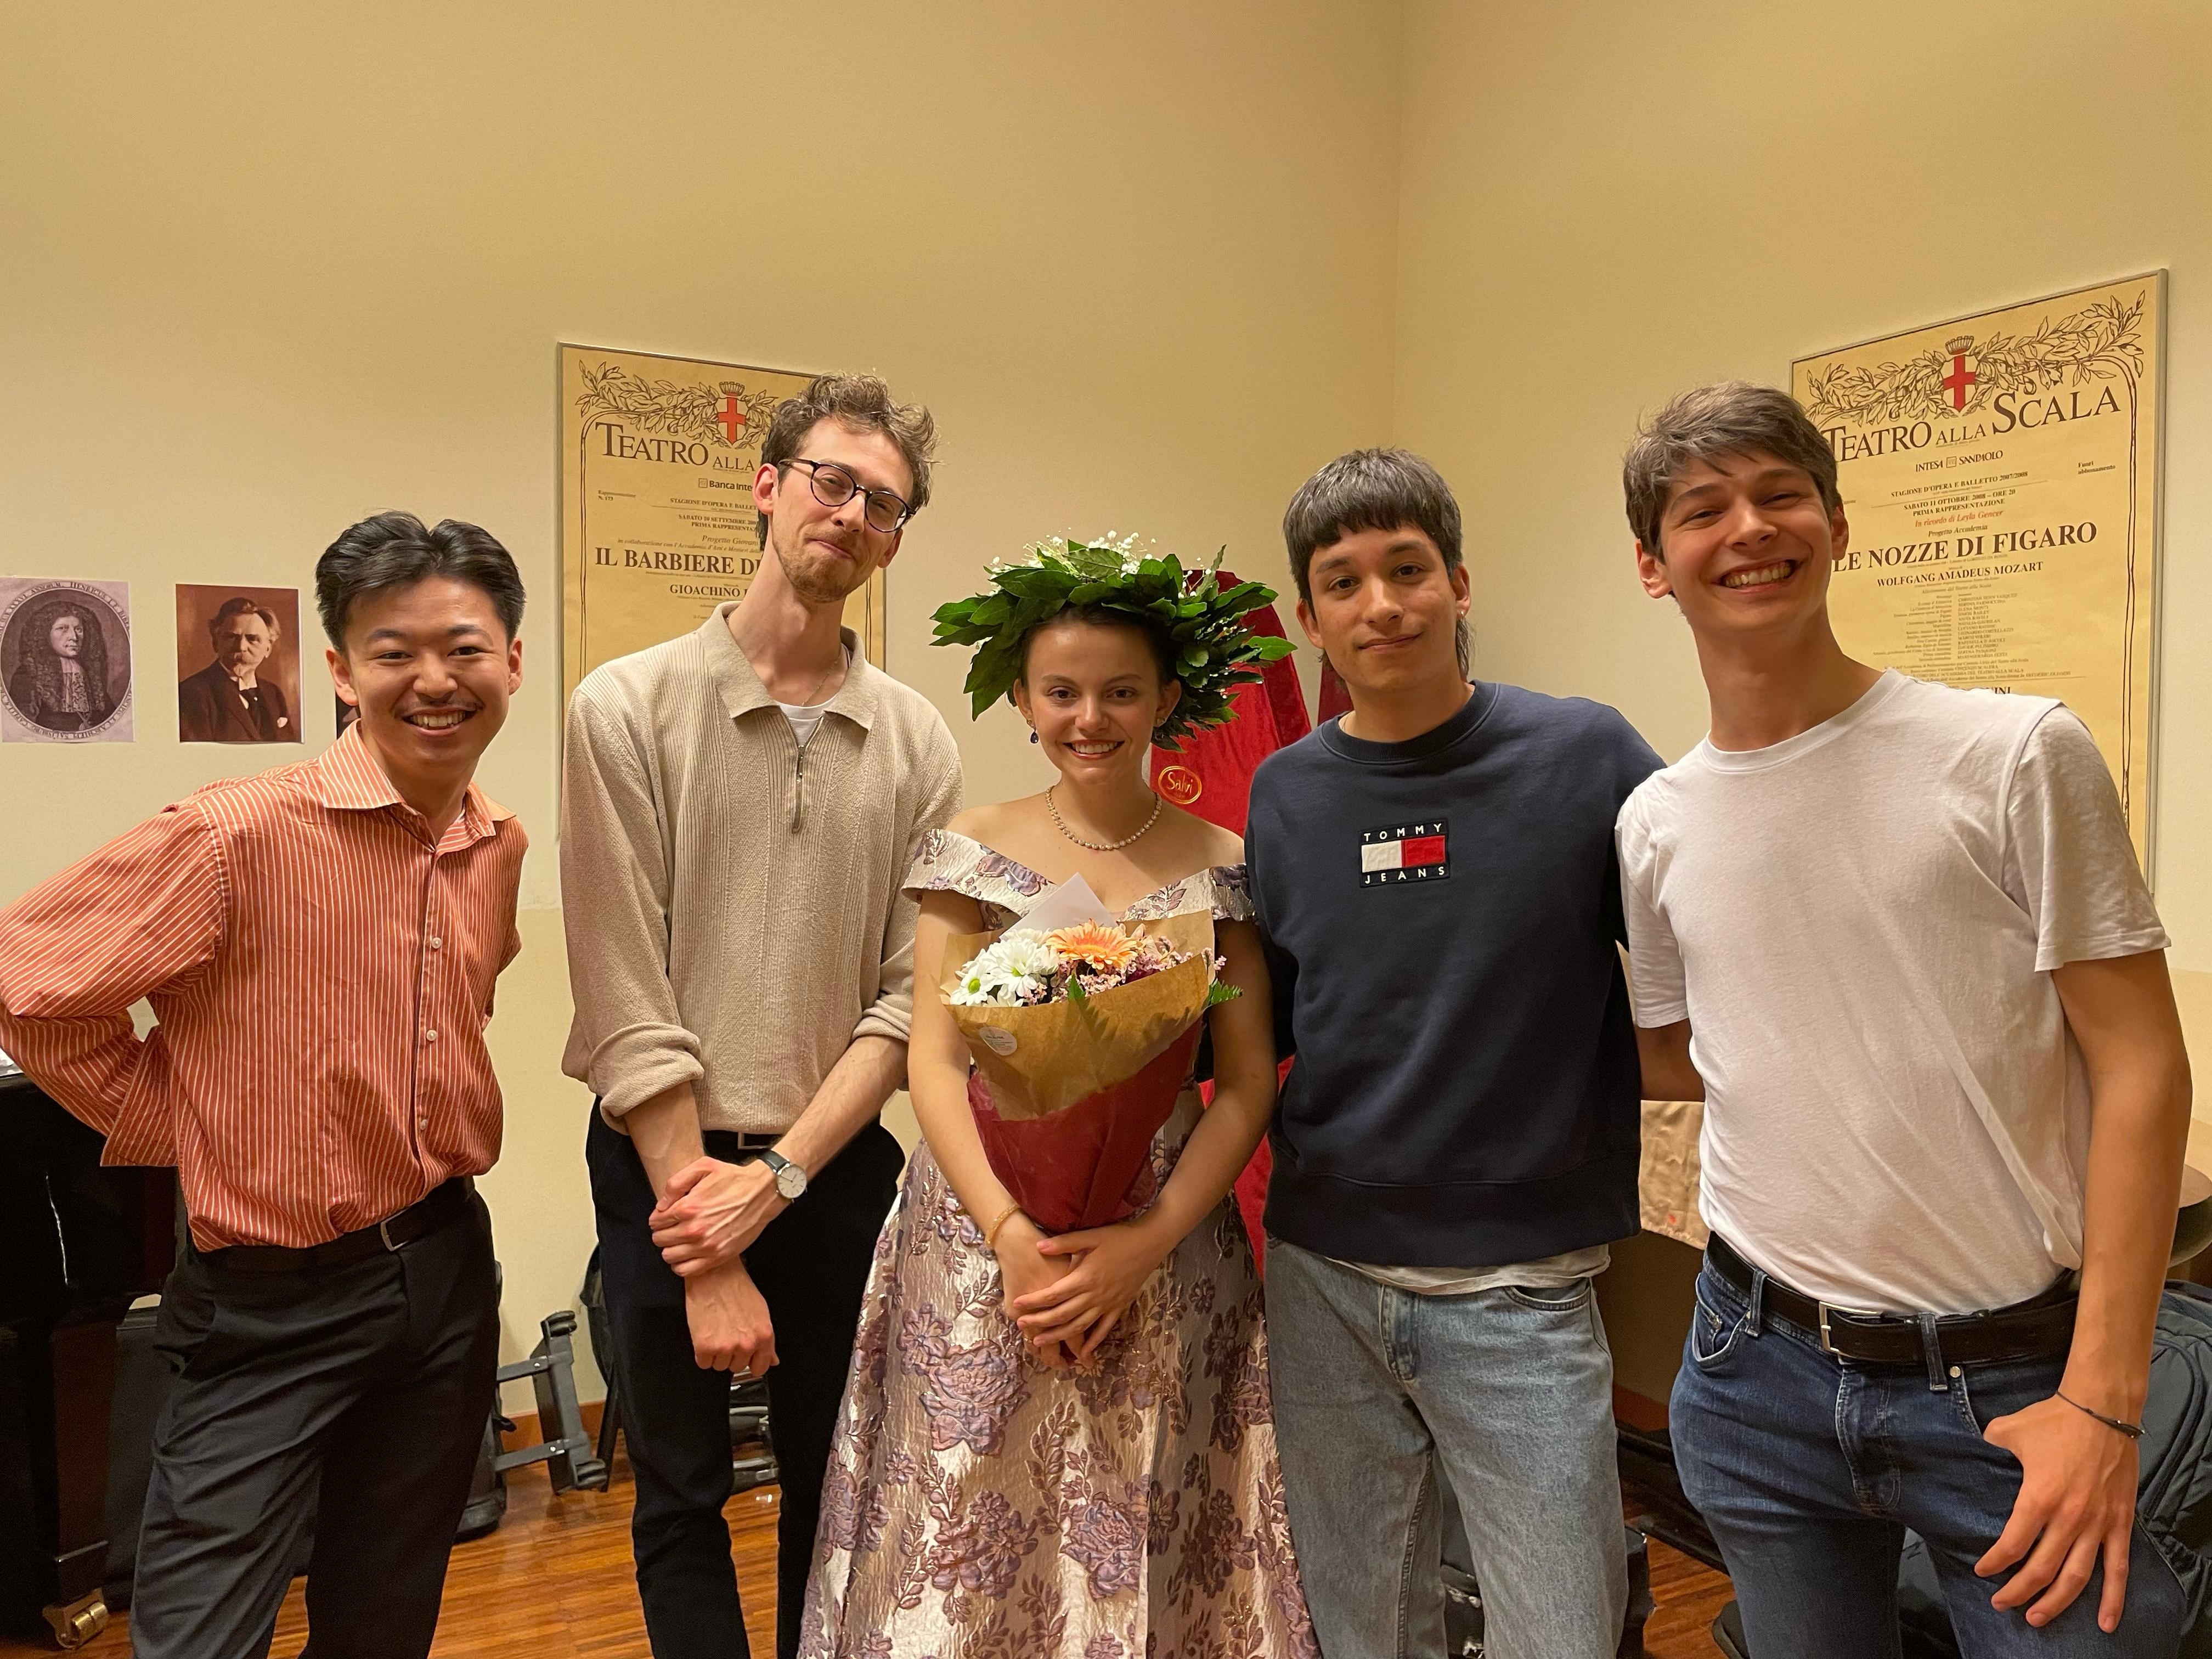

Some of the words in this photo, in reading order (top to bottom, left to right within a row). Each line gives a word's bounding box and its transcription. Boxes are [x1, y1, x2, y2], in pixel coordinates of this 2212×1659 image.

[1820, 421, 1932, 462] TEATRO
[1936, 423, 1987, 445] ALLA
[1992, 385, 2121, 435] SCALA
[595, 421, 709, 465] TEATRO
[713, 456, 755, 472] ALLA
[1915, 460, 1944, 472] INTESA
[709, 480, 735, 490] Banca
[736, 483, 752, 492] Inte
[1891, 487, 1923, 498] STAGIONE
[1923, 483, 1953, 493] D'OPERA
[1960, 476, 1998, 487] BALLETTO
[1903, 500, 1928, 510] SABATO
[1937, 494, 1970, 505] OTTOBRE
[1992, 489, 2007, 498] ORE
[1912, 509, 1934, 517] PRIMA
[1935, 498, 2006, 514] RAPPRESENTAZIONE
[1923, 517, 1947, 526] ricordo
[1956, 512, 1976, 522] Leyla
[1978, 510, 2004, 519] Gencer
[1954, 524, 1988, 534] Accademia
[702, 535, 731, 544] Progetto
[1832, 551, 1862, 572] LE
[1867, 540, 1949, 568] NOZZE
[1956, 535, 1985, 558] DI
[1992, 521, 2097, 554] FIGARO
[595, 547, 618, 566] IL
[624, 549, 735, 574] BARBIERE
[1877, 572, 1936, 588] WOLFGANG
[1937, 567, 1991, 582] AMADEUS
[1993, 561, 2044, 576] MOZART
[669, 584, 741, 597] GIOACHINO
[1166, 771, 1193, 795] Salvi
[1363, 823, 1442, 842] TOMMY
[1364, 866, 1445, 884] JEANS
